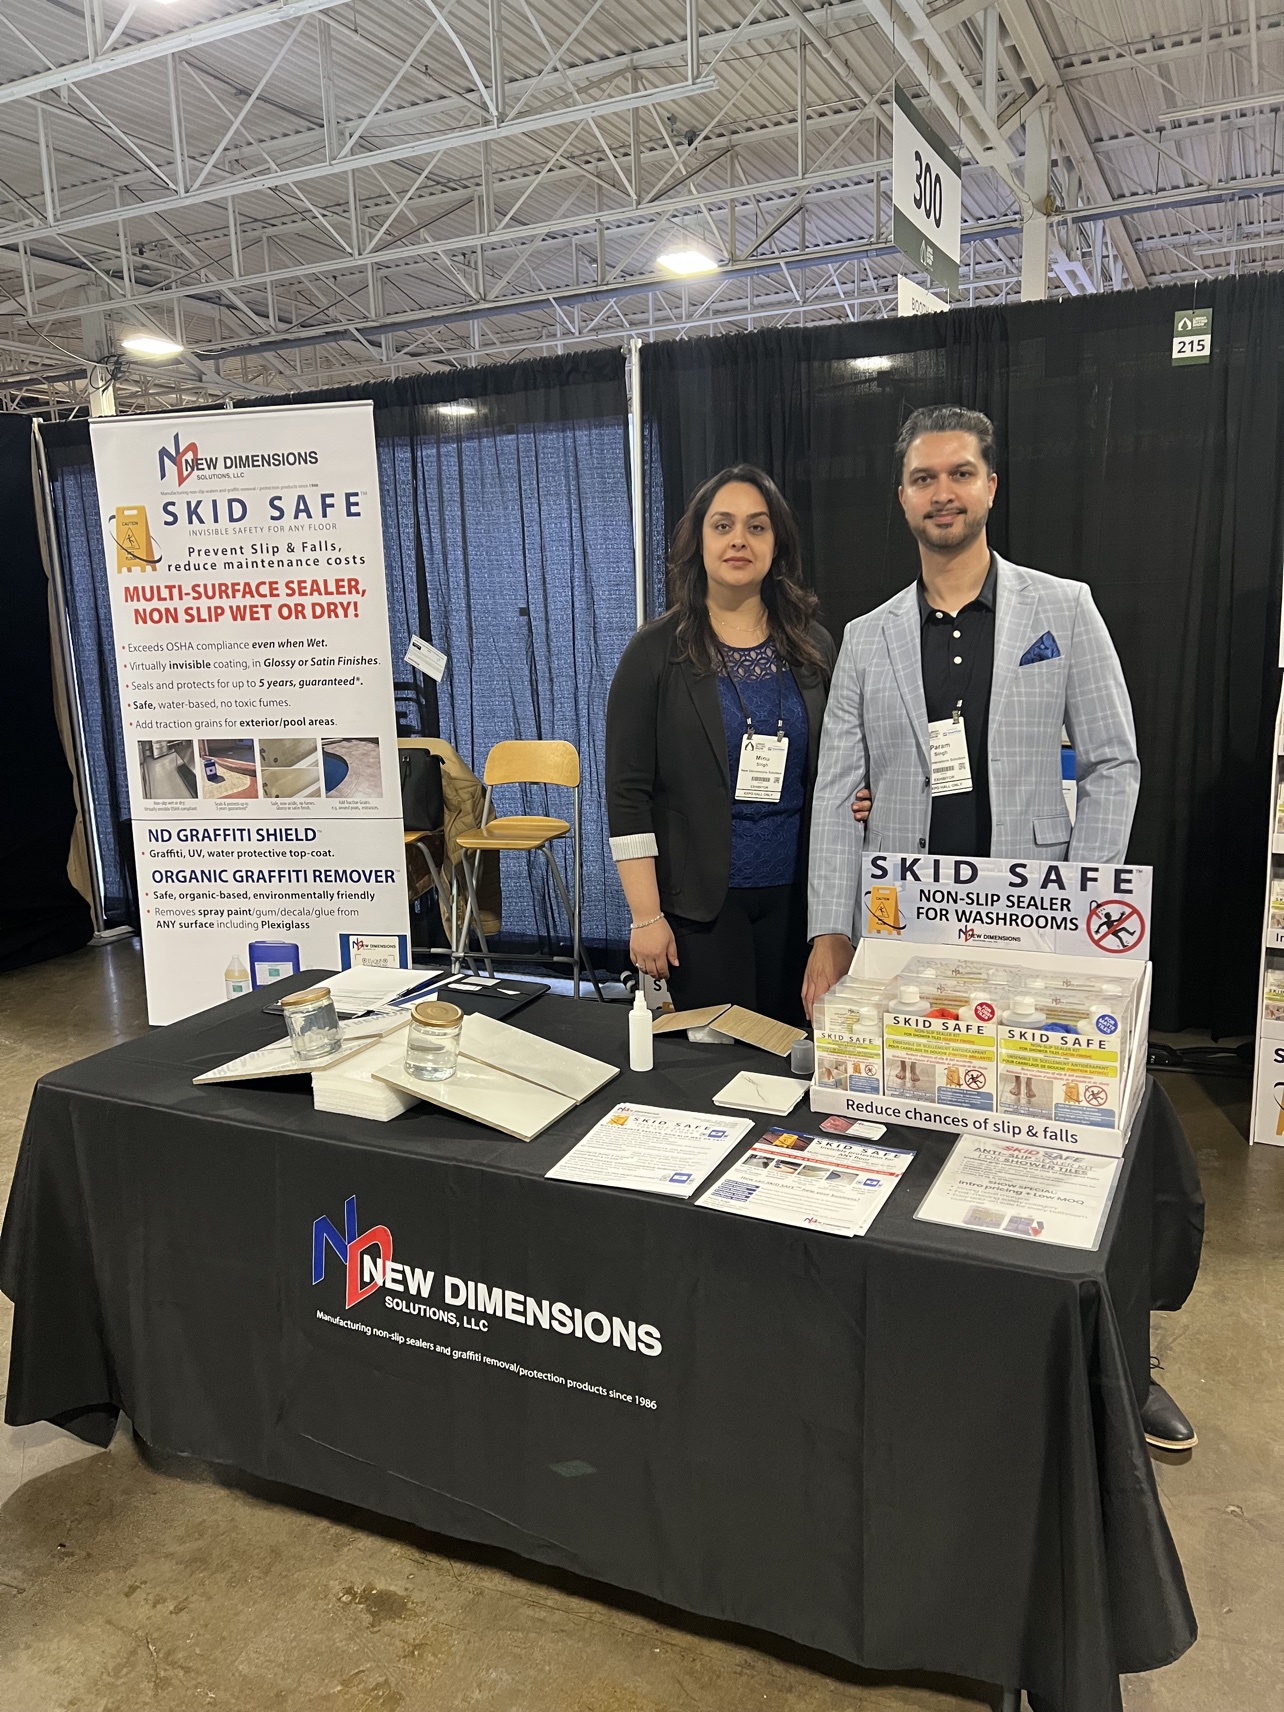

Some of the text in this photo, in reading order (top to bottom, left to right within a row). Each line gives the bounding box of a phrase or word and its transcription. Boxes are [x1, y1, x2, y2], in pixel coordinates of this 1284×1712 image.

[913, 150, 942, 229] 300
[1177, 339, 1205, 353] 215
[184, 450, 319, 472] NEW DIMENSIONS
[196, 473, 232, 481] SOLUTIONS,
[162, 491, 361, 526] SKID SAFE
[188, 523, 337, 537] INVISIBLE SAFETY FOR ANY FLOOR
[187, 540, 342, 557] Prevent Slip & Falls,
[167, 555, 366, 572] reduce maintenance costs
[123, 577, 367, 603] MULTI-SURFACE SEALER,
[133, 600, 360, 625] NON SLIP WET OR DRY!
[128, 638, 328, 652] Exceeds OSHA compliance even when Wet.
[129, 660, 167, 672] Virtually
[168, 659, 211, 670] invisible
[213, 659, 250, 670] coating,
[252, 658, 261, 668] in
[263, 658, 296, 669] Glossy
[310, 656, 335, 666] Satin
[337, 656, 381, 666] Finishes.
[131, 681, 154, 690] Seals
[156, 680, 174, 690] and
[176, 680, 215, 691] protects
[217, 679, 229, 688] for
[232, 681, 244, 691] up
[246, 680, 256, 688] to
[258, 678, 265, 687] 5
[267, 679, 296, 689] years,
[133, 698, 291, 710] Safe, water-based, no toxic fumes.
[135, 717, 337, 730] Add traction grains for exterior/pool areas.
[148, 827, 317, 842] ND GRAFFITI SHIELD
[149, 849, 335, 859] Graffiti, UV, water protective top-coat.
[151, 869, 396, 884] ORGANIC GRAFFITI REMOVER
[870, 855, 1134, 894] SKID SAFE
[153, 890, 376, 902] Safe, organic-based, environmentally friendly
[918, 888, 1072, 913] NON-SLIP SEALER
[154, 906, 359, 919] Removes spray paint/gum/decala/glue from
[916, 906, 1079, 932] FOR WASHROOMS
[156, 919, 311, 931] ANY surface including Plexiglass
[983, 934, 1022, 942] DIMENSIONS
[982, 1004, 992, 1013] FOR
[893, 1015, 985, 1035] SKID SAFE
[1097, 1022, 1111, 1034] TILES
[1098, 1018, 1116, 1031] MATTE
[1104, 1016, 1115, 1025] FOR
[821, 1032, 874, 1045] SKID SAFE
[1007, 1029, 1107, 1050] SKID SAFE
[633, 1117, 711, 1131] SKID SAFE
[846, 1098, 1079, 1144] Reduce chances of slip & falls
[815, 1140, 901, 1159] SKID SAFE
[1002, 1145, 1085, 1163] SKID SAFE
[973, 1147, 1032, 1160] ANTI-SLIP
[1034, 1156, 1075, 1168] SEALER
[1003, 1158, 1055, 1170] SHOWER
[1059, 1166, 1088, 1175] TILES
[958, 1180, 983, 1188] Intro
[984, 1184, 1023, 1195] pricing
[363, 1253, 663, 1357] NEW DIMENSIONS
[384, 1295, 489, 1333] SOLUTIONS, LLC
[316, 1309, 658, 1411] Manufacturing non-slip sealers and graffiti removal/protection products since 1986
